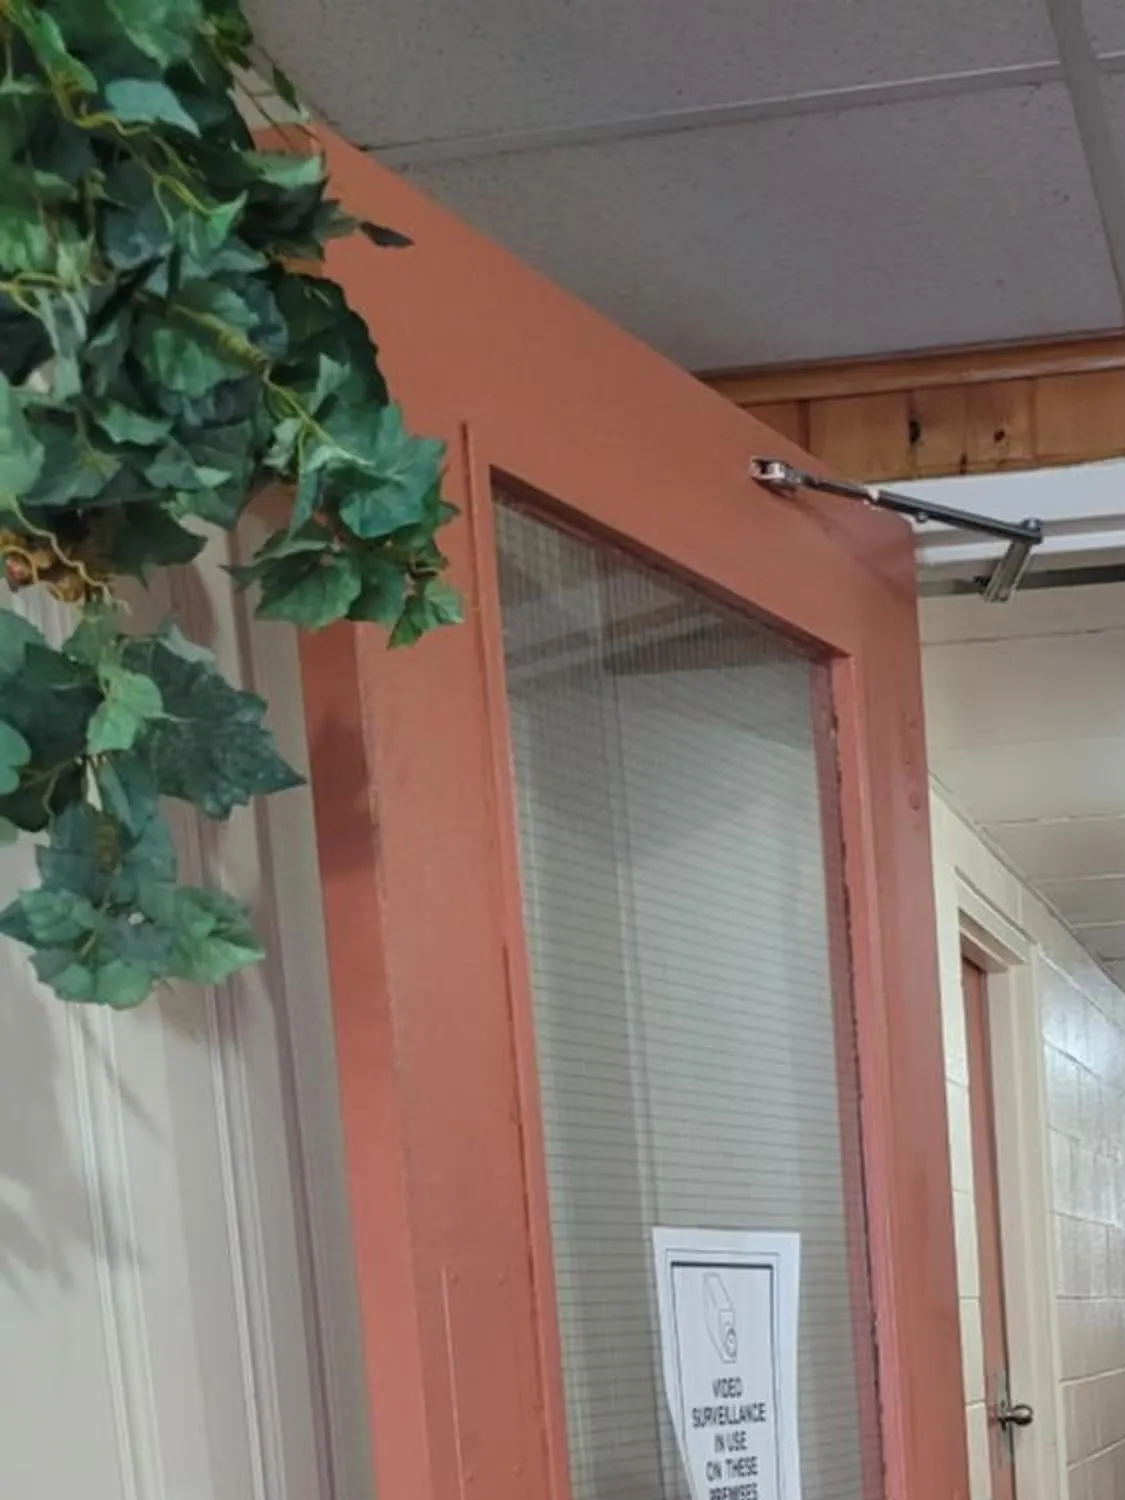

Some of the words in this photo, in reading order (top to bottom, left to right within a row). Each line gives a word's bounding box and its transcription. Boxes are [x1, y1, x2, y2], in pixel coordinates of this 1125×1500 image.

[712, 1377, 743, 1398] VIDEO
[691, 1403, 766, 1428] SURVEILLANCE
[714, 1433, 725, 1453] IN
[727, 1431, 747, 1451] USE
[705, 1461, 722, 1482] ON
[725, 1456, 758, 1477] THESE
